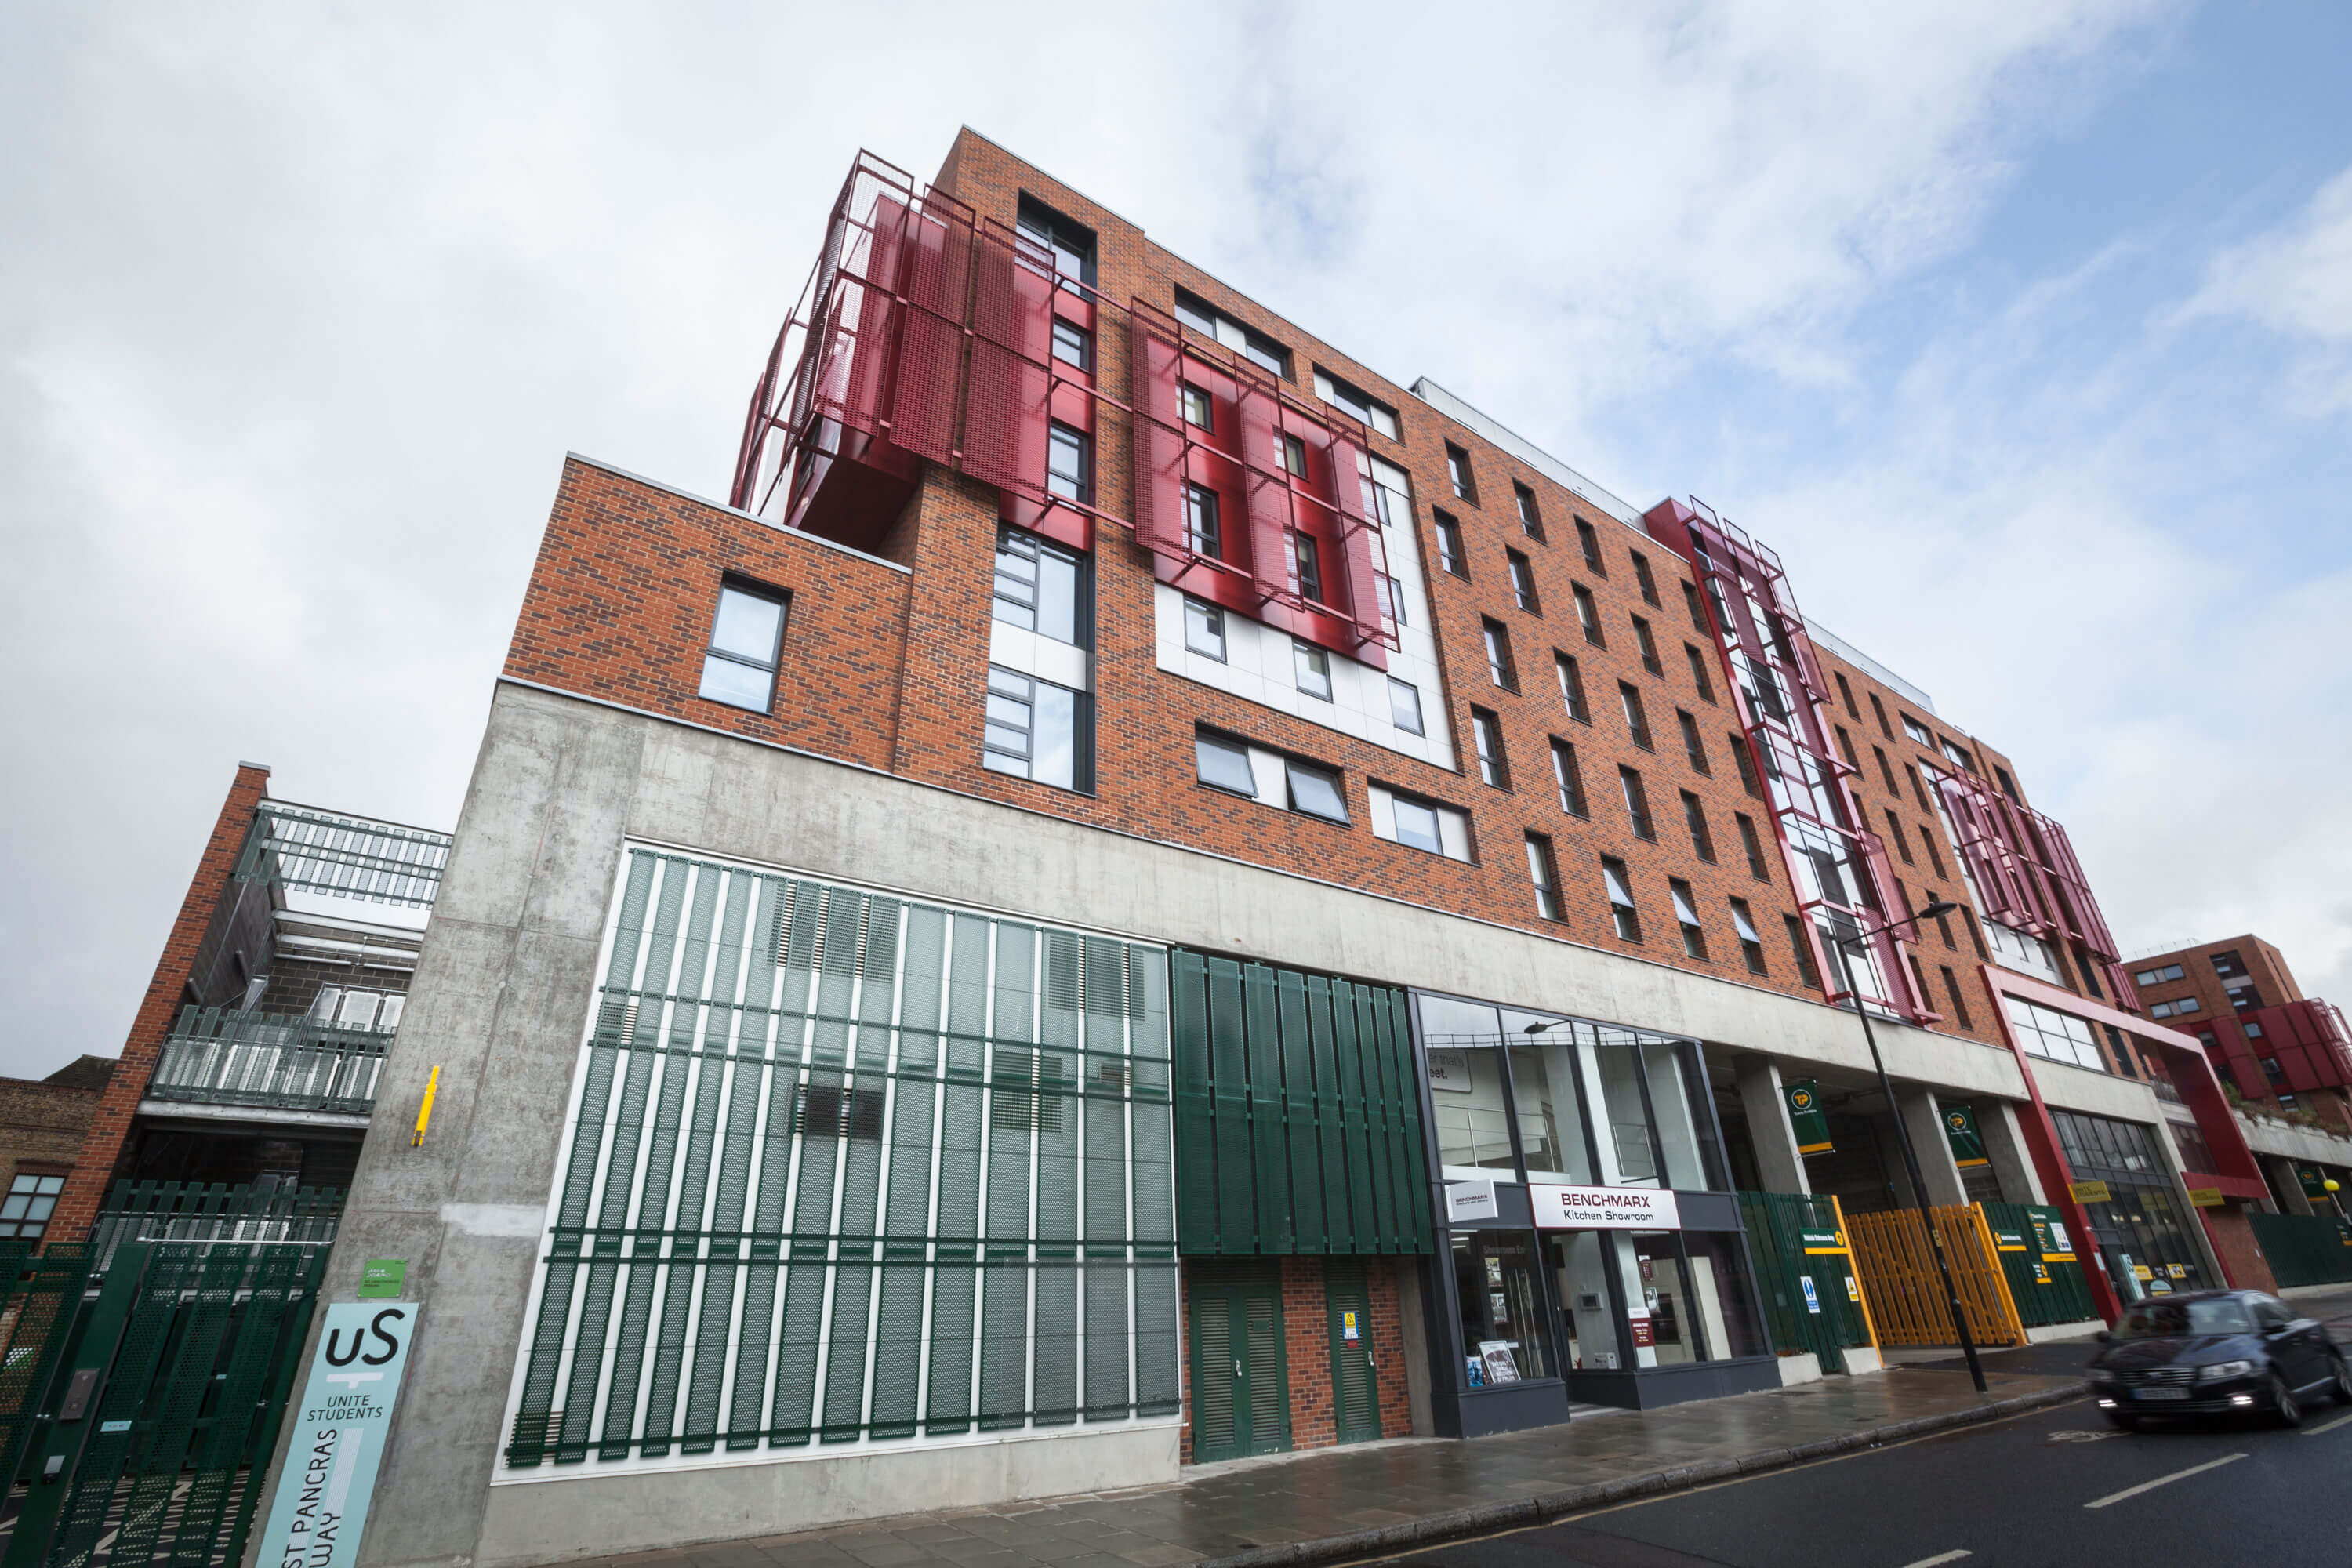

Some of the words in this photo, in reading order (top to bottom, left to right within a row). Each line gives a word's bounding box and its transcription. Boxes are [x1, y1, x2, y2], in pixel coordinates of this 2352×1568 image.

[1561, 1193, 1651, 1208] BENCHMARX
[1563, 1210, 1602, 1221] Kitchen
[1605, 1210, 1654, 1221] Showroom
[327, 1395, 371, 1407] UNITE
[307, 1406, 383, 1421] STUDENTS
[291, 1428, 338, 1534] PANCRAS
[308, 1512, 341, 1568] WAY
[281, 1544, 307, 1568] ST
